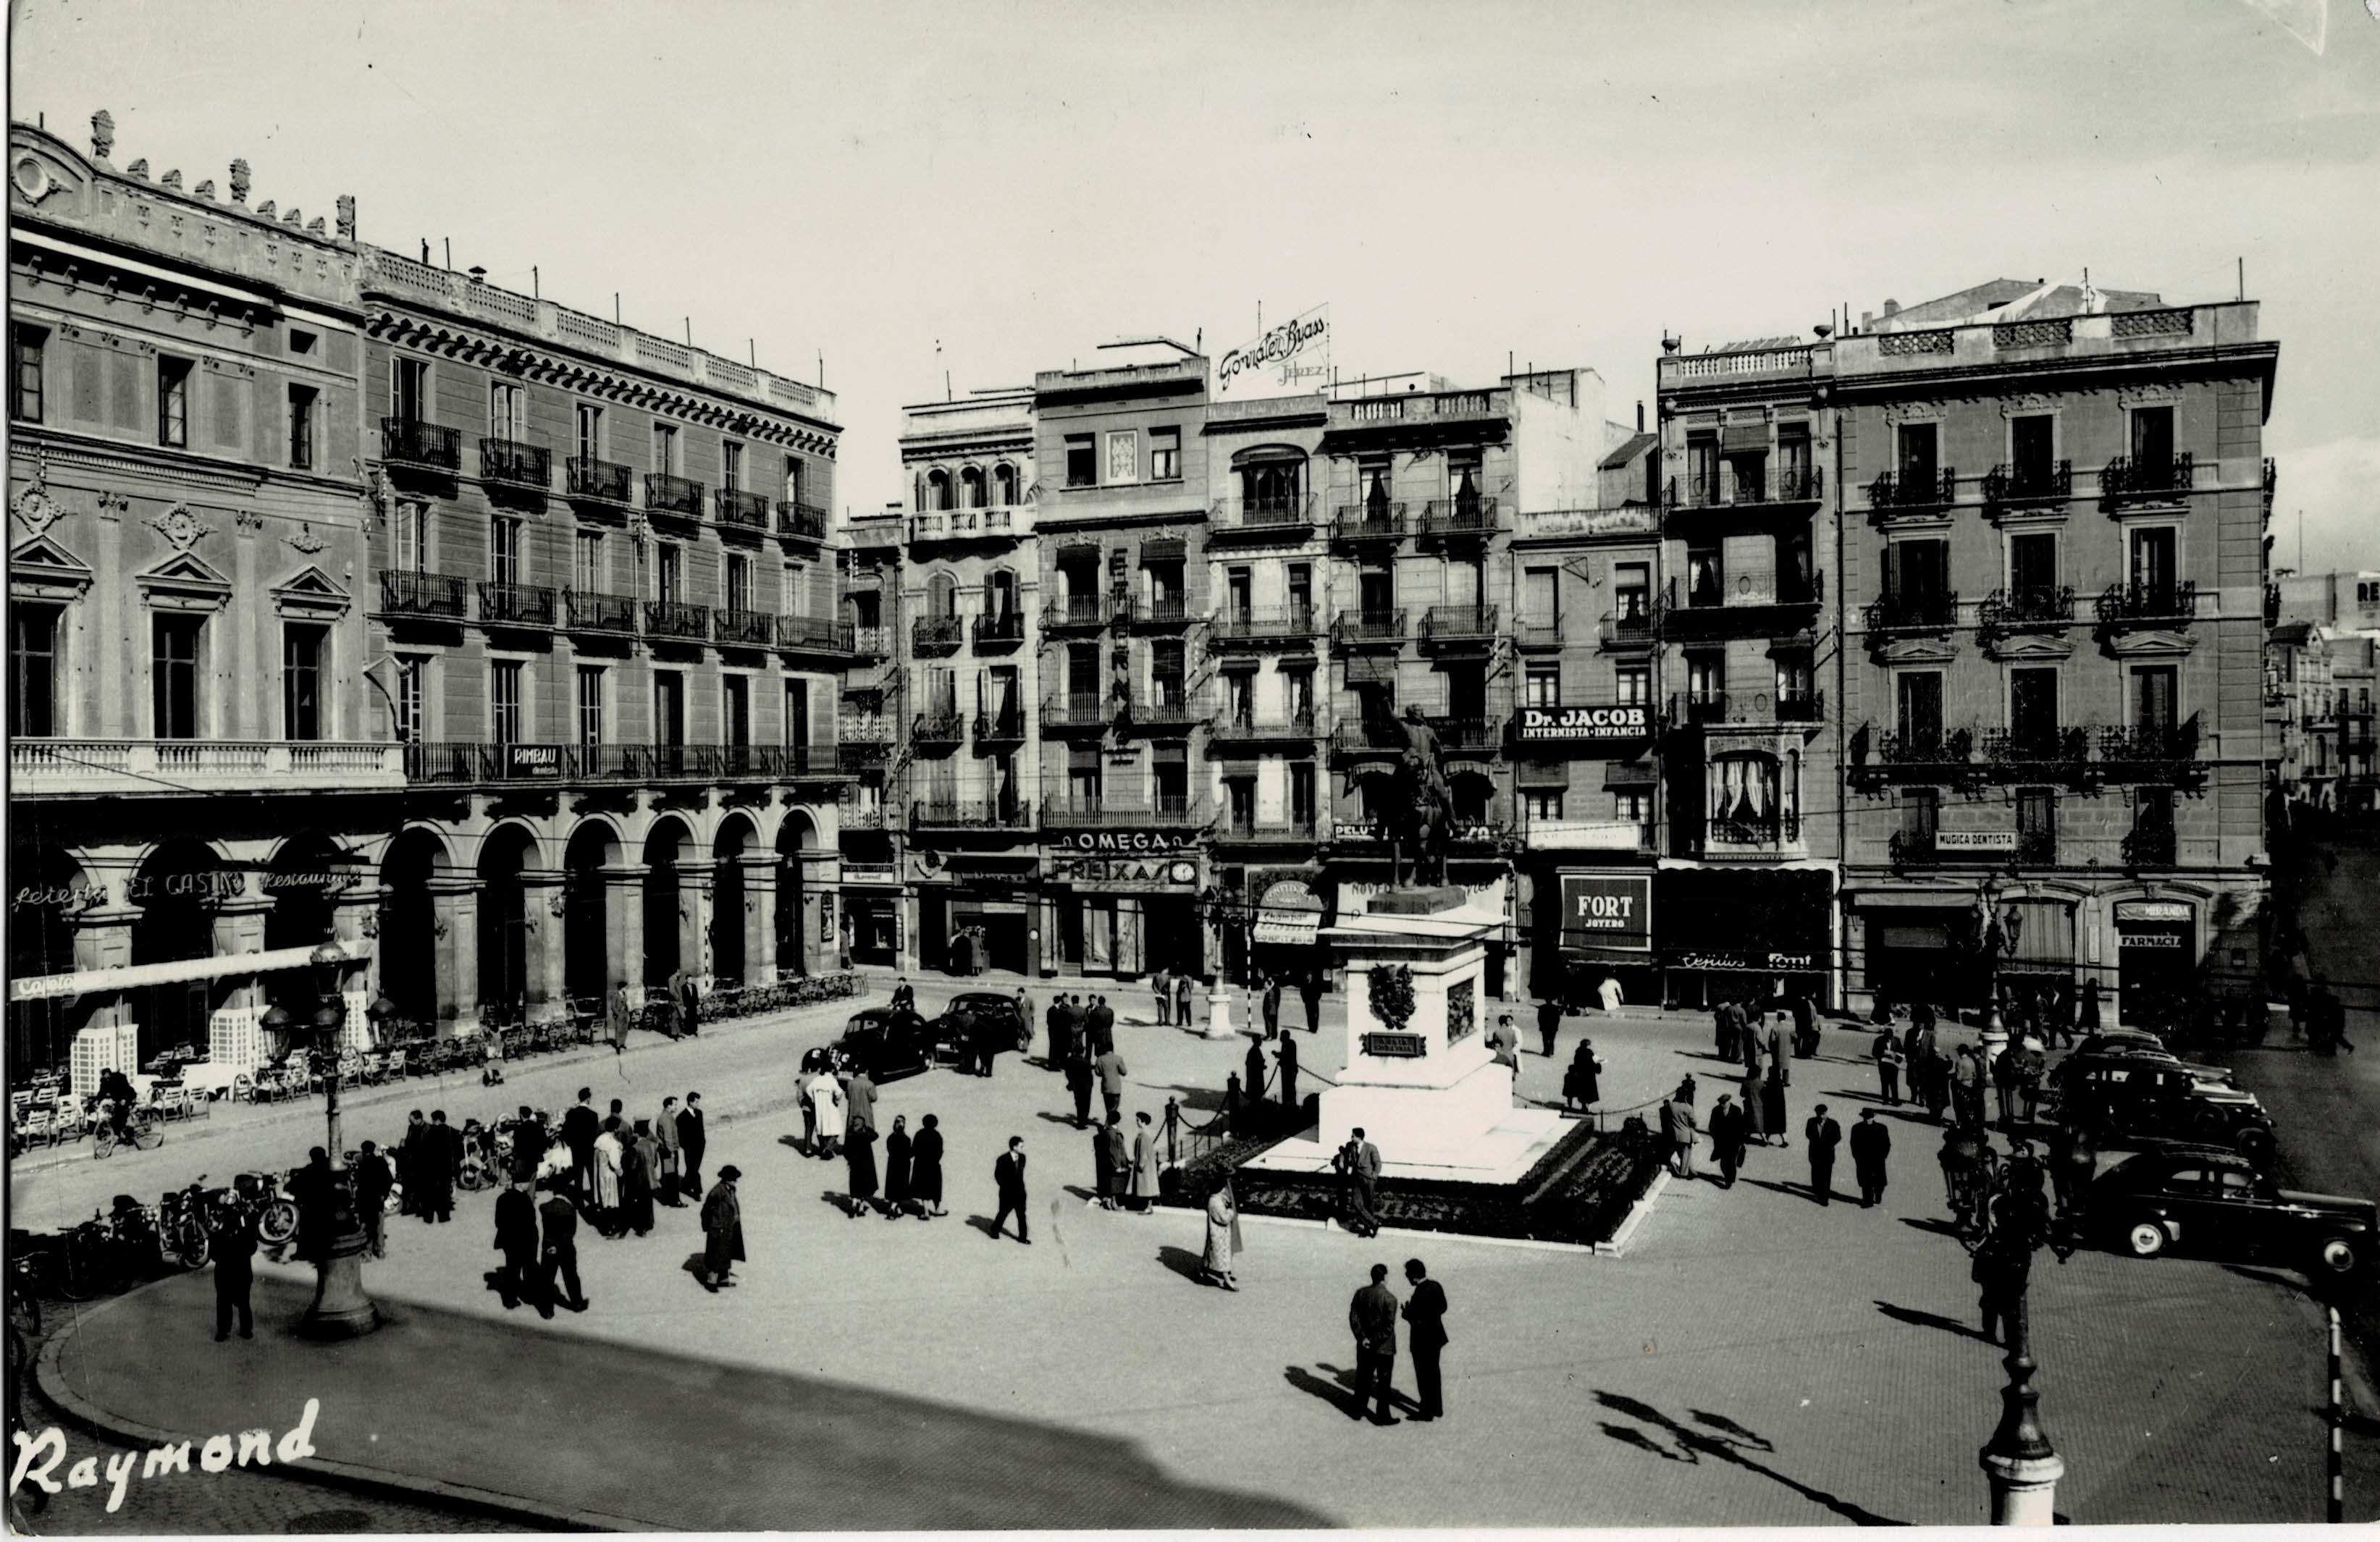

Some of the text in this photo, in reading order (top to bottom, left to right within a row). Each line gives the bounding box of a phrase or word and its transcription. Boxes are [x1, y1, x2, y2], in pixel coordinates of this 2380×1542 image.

[1524, 709, 1645, 728] Dr. JACOB
[514, 748, 557, 764] RIMBAU
[1078, 833, 1169, 850] OMEGA
[1973, 835, 2013, 844] DENTISTA
[1055, 859, 1169, 881] FREIXAS
[166, 872, 245, 898] CASINO
[1578, 896, 1633, 917] FORT
[2145, 905, 2190, 917] MIRANDA
[1585, 919, 1625, 928] JOYERO
[1768, 953, 1812, 969] Font
